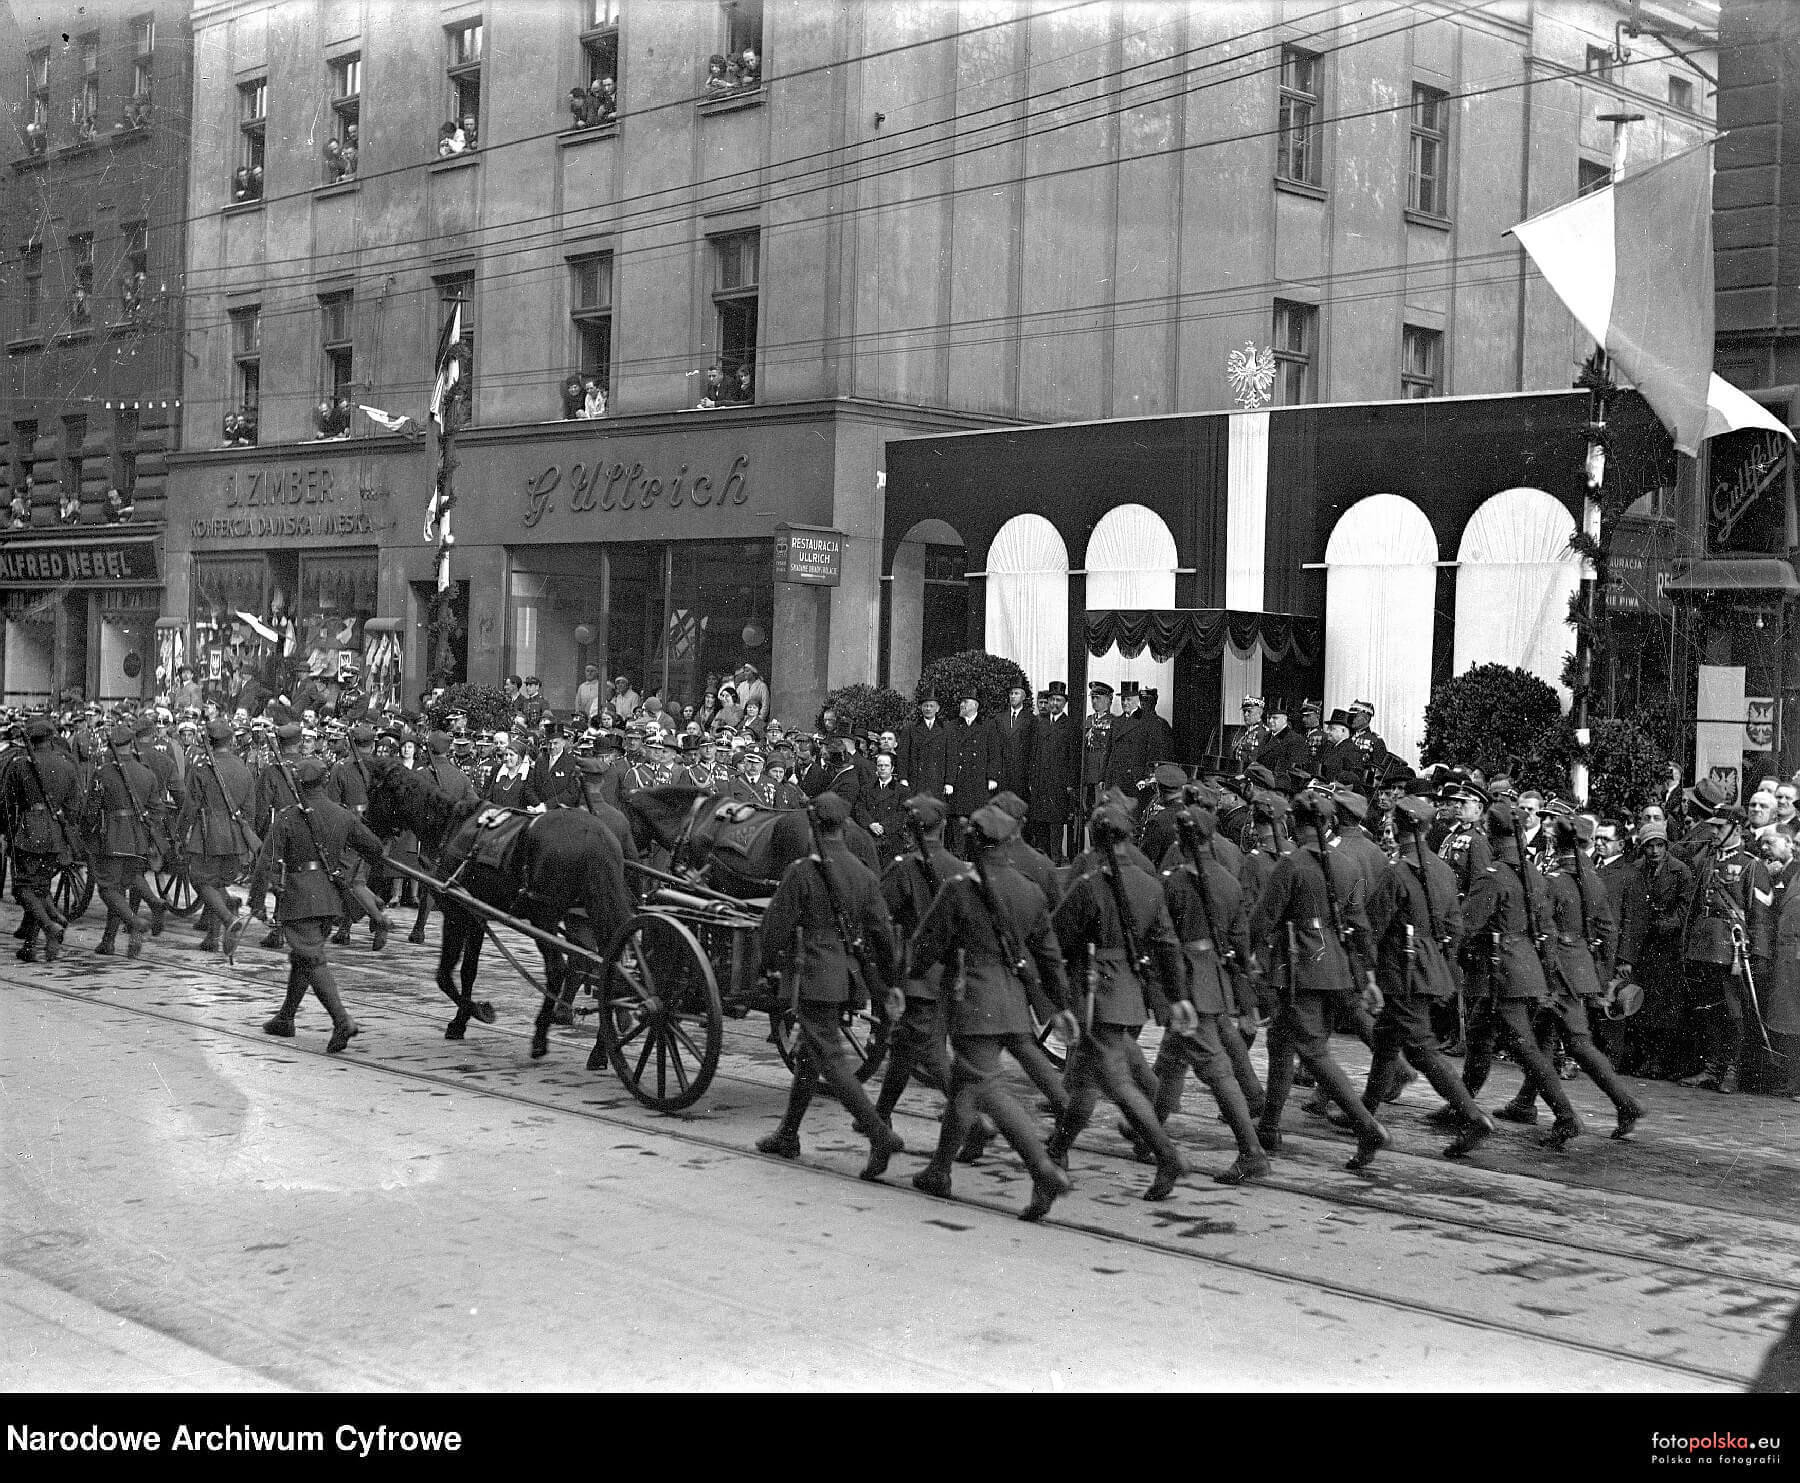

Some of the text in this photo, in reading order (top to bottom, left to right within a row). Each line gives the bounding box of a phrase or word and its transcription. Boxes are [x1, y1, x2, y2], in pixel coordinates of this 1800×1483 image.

[247, 467, 334, 507] ZIMBER
[570, 454, 749, 512] Ullrich
[190, 516, 255, 539] KONFEKCJA
[258, 514, 314, 537] DAMSKA
[326, 512, 374, 537] MĘSKA
[791, 537, 839, 552] RESTAURACJA
[799, 551, 831, 564] ULLRICH
[0, 550, 132, 577] ALFRED NEBEL
